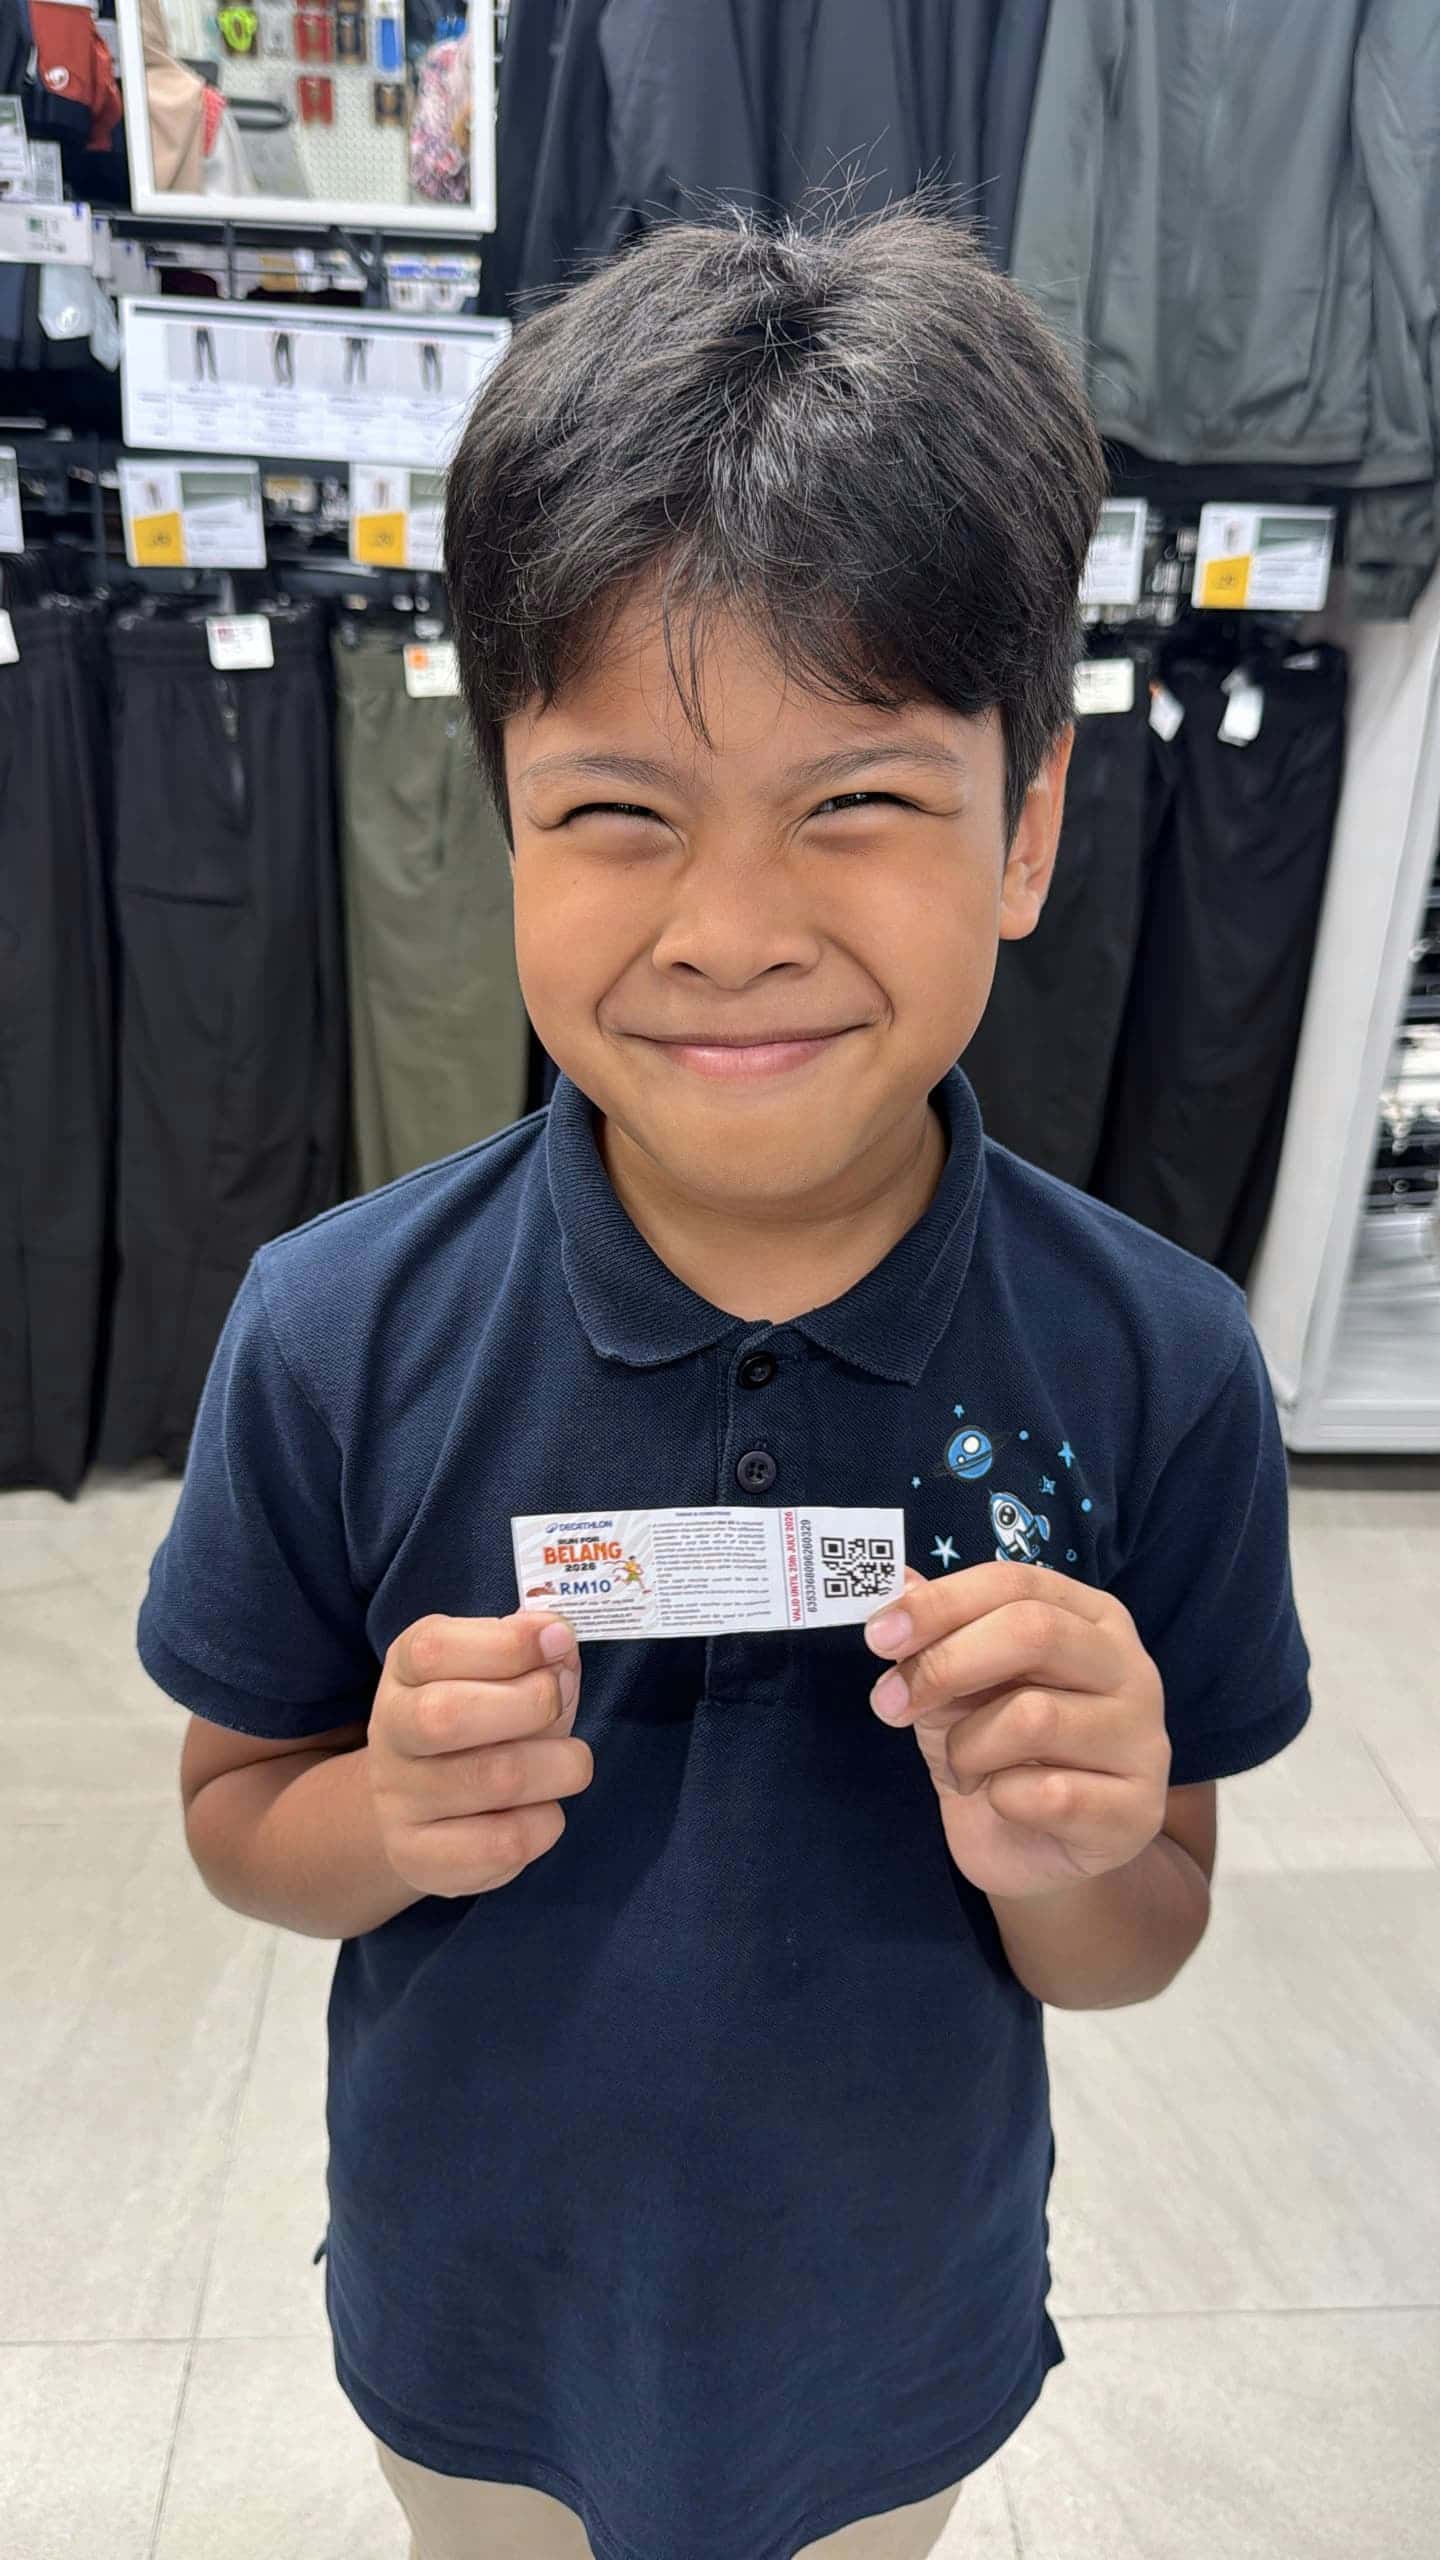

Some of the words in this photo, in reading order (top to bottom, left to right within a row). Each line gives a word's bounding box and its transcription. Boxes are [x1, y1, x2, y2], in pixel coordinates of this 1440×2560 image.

[559, 1520, 612, 1531] DECATHLON
[784, 1511, 794, 1531] 2026
[786, 1534, 796, 1552] JULY
[544, 1542, 622, 1564] BELANG
[565, 1562, 596, 1572] 2026
[560, 1579, 612, 1595] RM10
[790, 1574, 800, 1597] UNTIL
[791, 1598, 801, 1622] VALID
